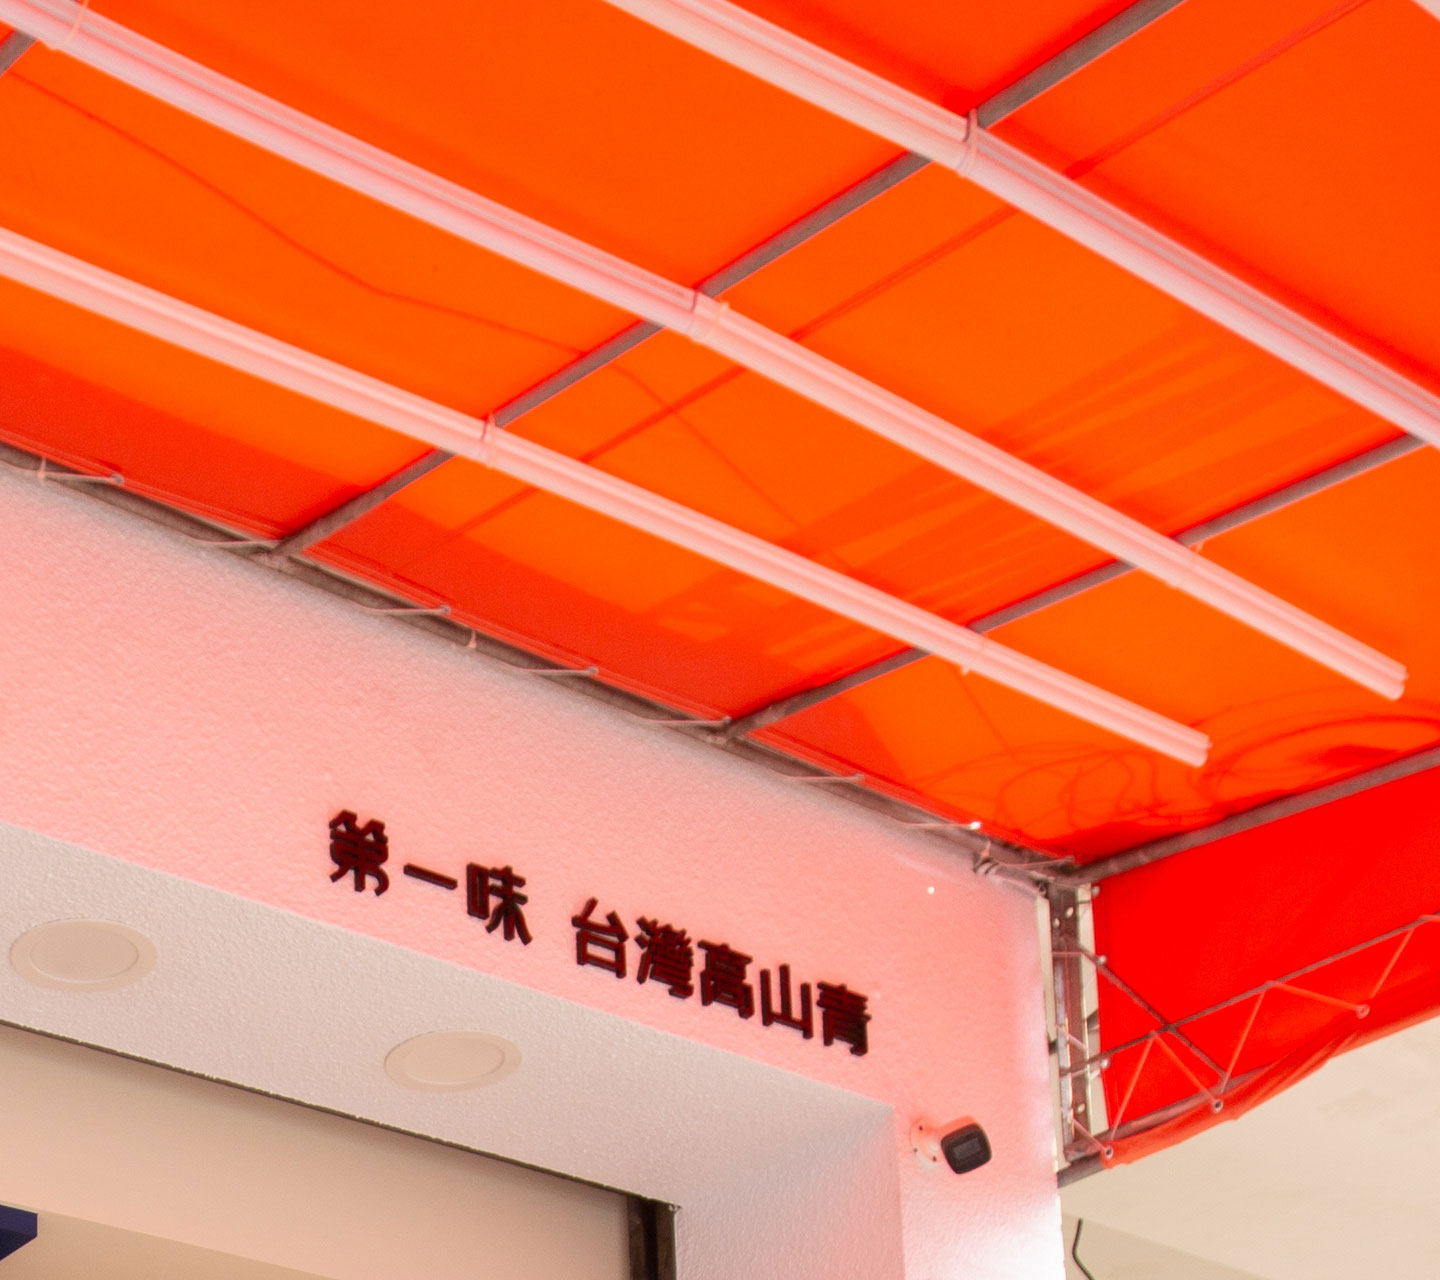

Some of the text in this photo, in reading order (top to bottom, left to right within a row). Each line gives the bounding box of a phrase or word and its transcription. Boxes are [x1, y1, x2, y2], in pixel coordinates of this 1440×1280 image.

[329, 810, 872, 1056] 第一味 台灣高山青
